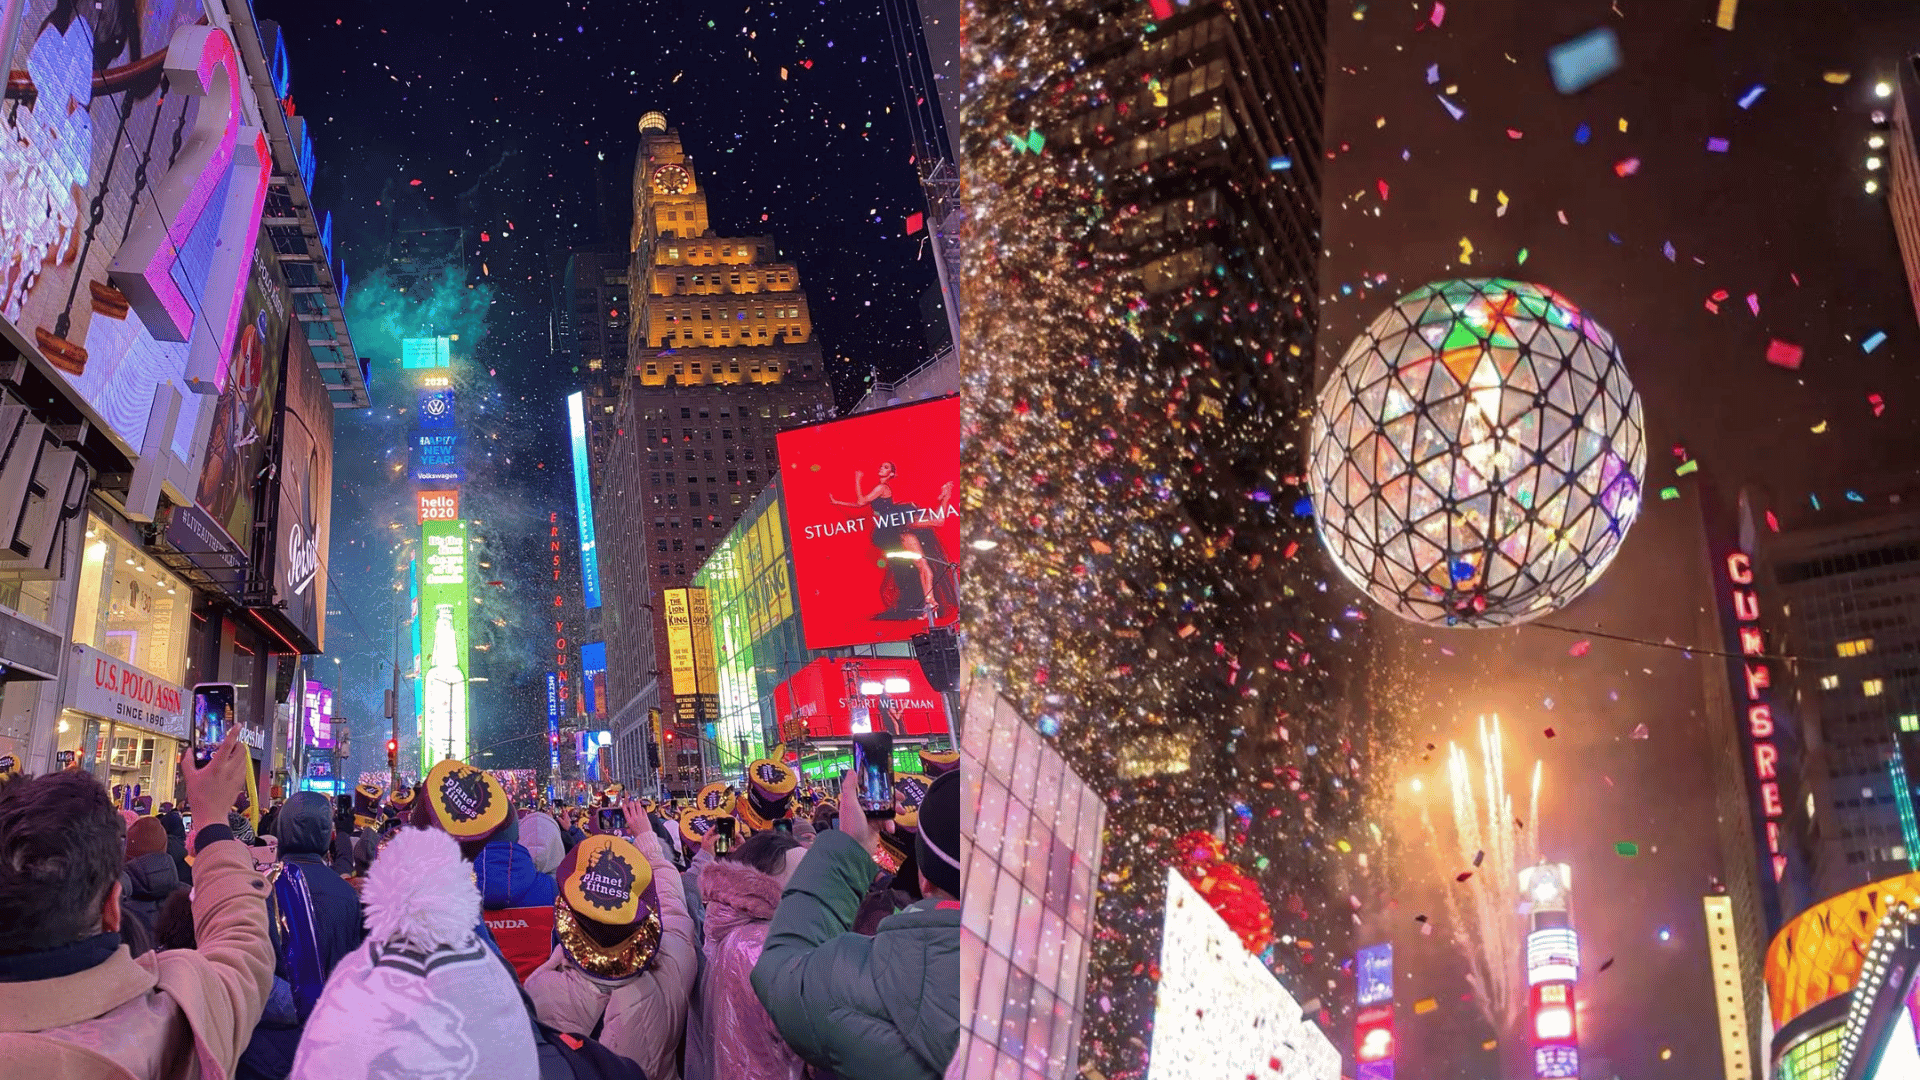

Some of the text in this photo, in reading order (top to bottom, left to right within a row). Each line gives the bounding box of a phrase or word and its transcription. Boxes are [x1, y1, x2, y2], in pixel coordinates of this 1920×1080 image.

[420, 436, 457, 446] HAPPY
[424, 446, 452, 455] NEW
[421, 455, 455, 465] YEAR!
[421, 496, 454, 508] hello
[421, 508, 455, 518] 2020
[804, 503, 960, 540] STUART WEITZMA
[550, 512, 561, 580] ERNST
[554, 595, 563, 607] &
[669, 598, 682, 606] THE
[668, 606, 685, 615] LION
[668, 614, 693, 626] KING
[555, 621, 569, 699] YOUNG
[95, 658, 118, 692] U.S.
[121, 669, 153, 704] POLO
[879, 698, 935, 709] WEITZMAN
[117, 703, 143, 721] SINCE
[146, 711, 164, 727] 1890
[445, 778, 477, 807] planet
[445, 787, 478, 818] fitness
[583, 871, 623, 888] planet
[586, 880, 630, 900] fitness
[485, 919, 529, 930] ONDA
